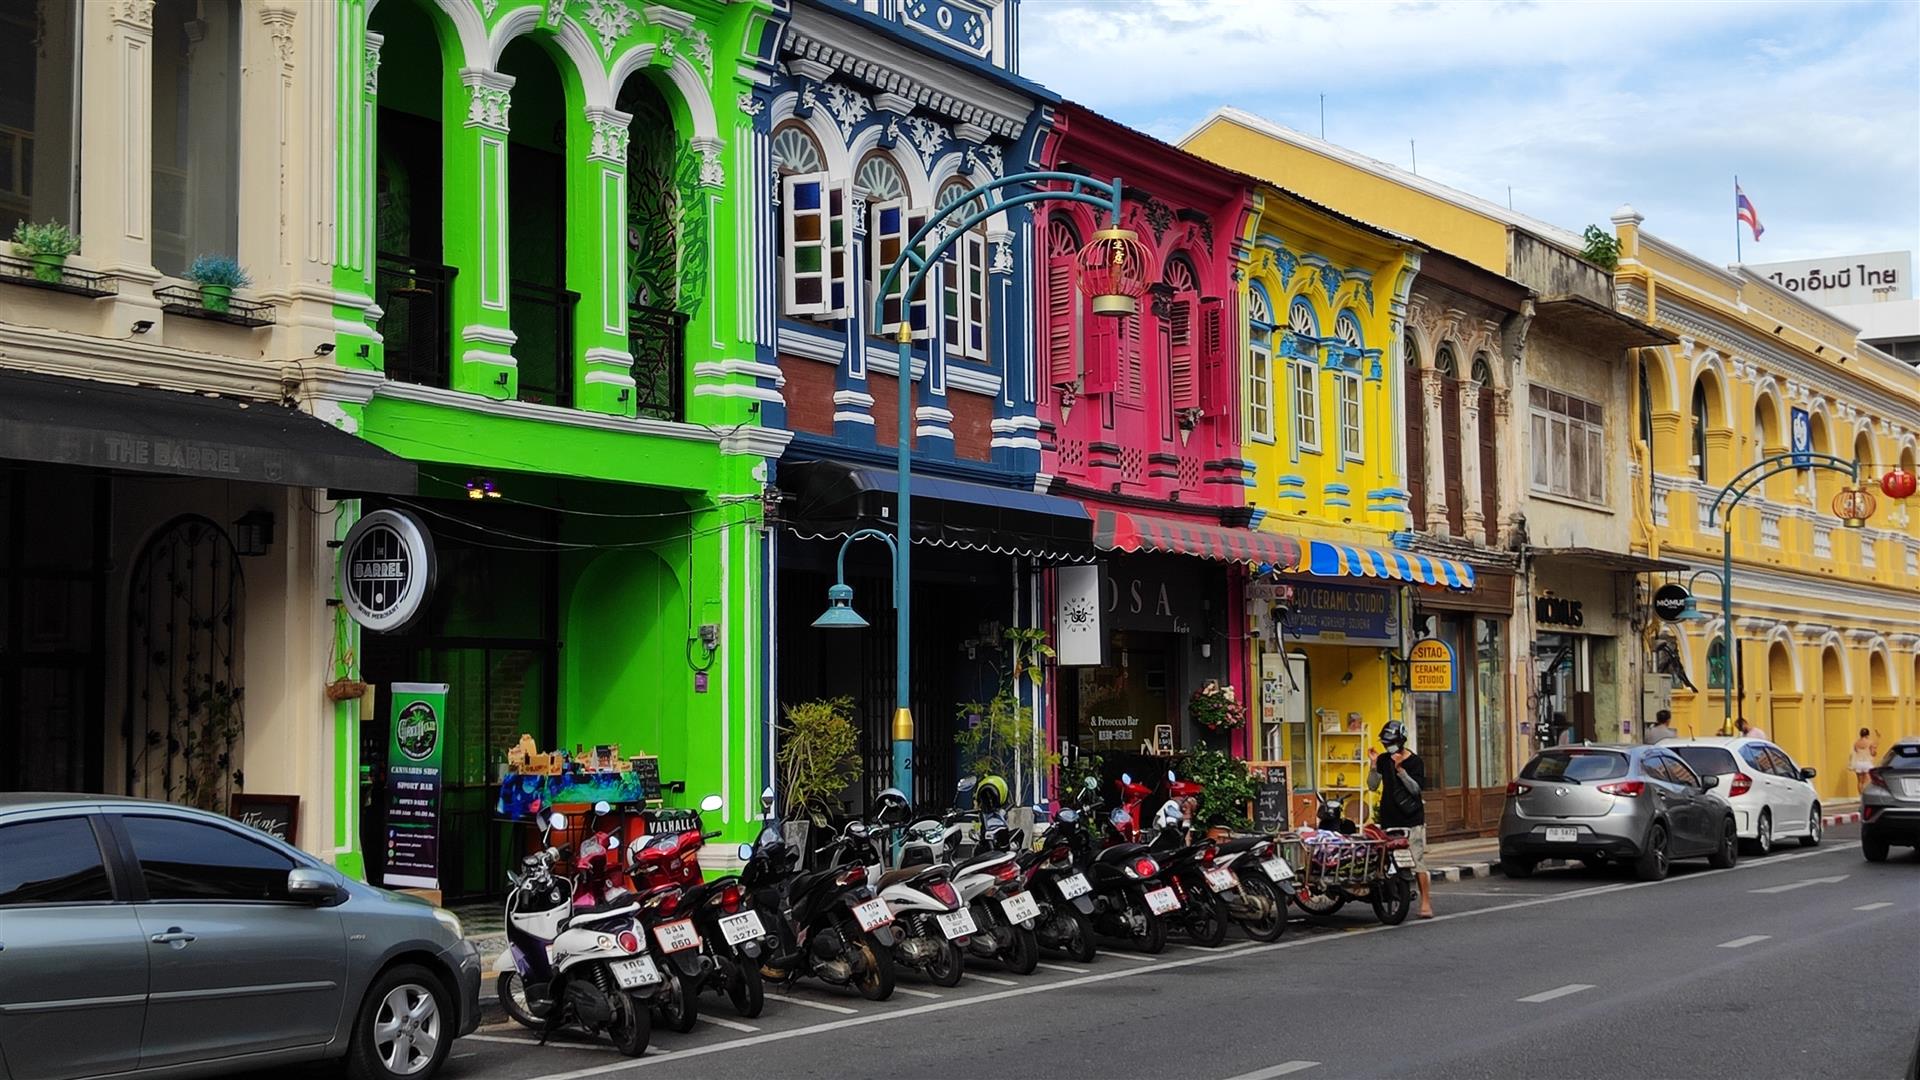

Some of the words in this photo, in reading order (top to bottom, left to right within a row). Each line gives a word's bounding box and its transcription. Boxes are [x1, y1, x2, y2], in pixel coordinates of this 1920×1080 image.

[1857, 264, 1896, 286] ไทย
[104, 437, 149, 465] THE
[153, 441, 240, 474] BARREL
[355, 562, 404, 578] BARREL
[1311, 588, 1353, 612] CERAMIC
[1355, 592, 1385, 614] STUDIO
[1417, 647, 1443, 658] SITAO
[1414, 664, 1447, 674] CERAMIC
[1417, 675, 1444, 684] STUDIO
[1090, 715, 1097, 726] &
[1098, 716, 1127, 726] Prosecco
[1127, 716, 1139, 726] Bar
[904, 758, 912, 770] 2
[622, 972, 655, 986] 5732
